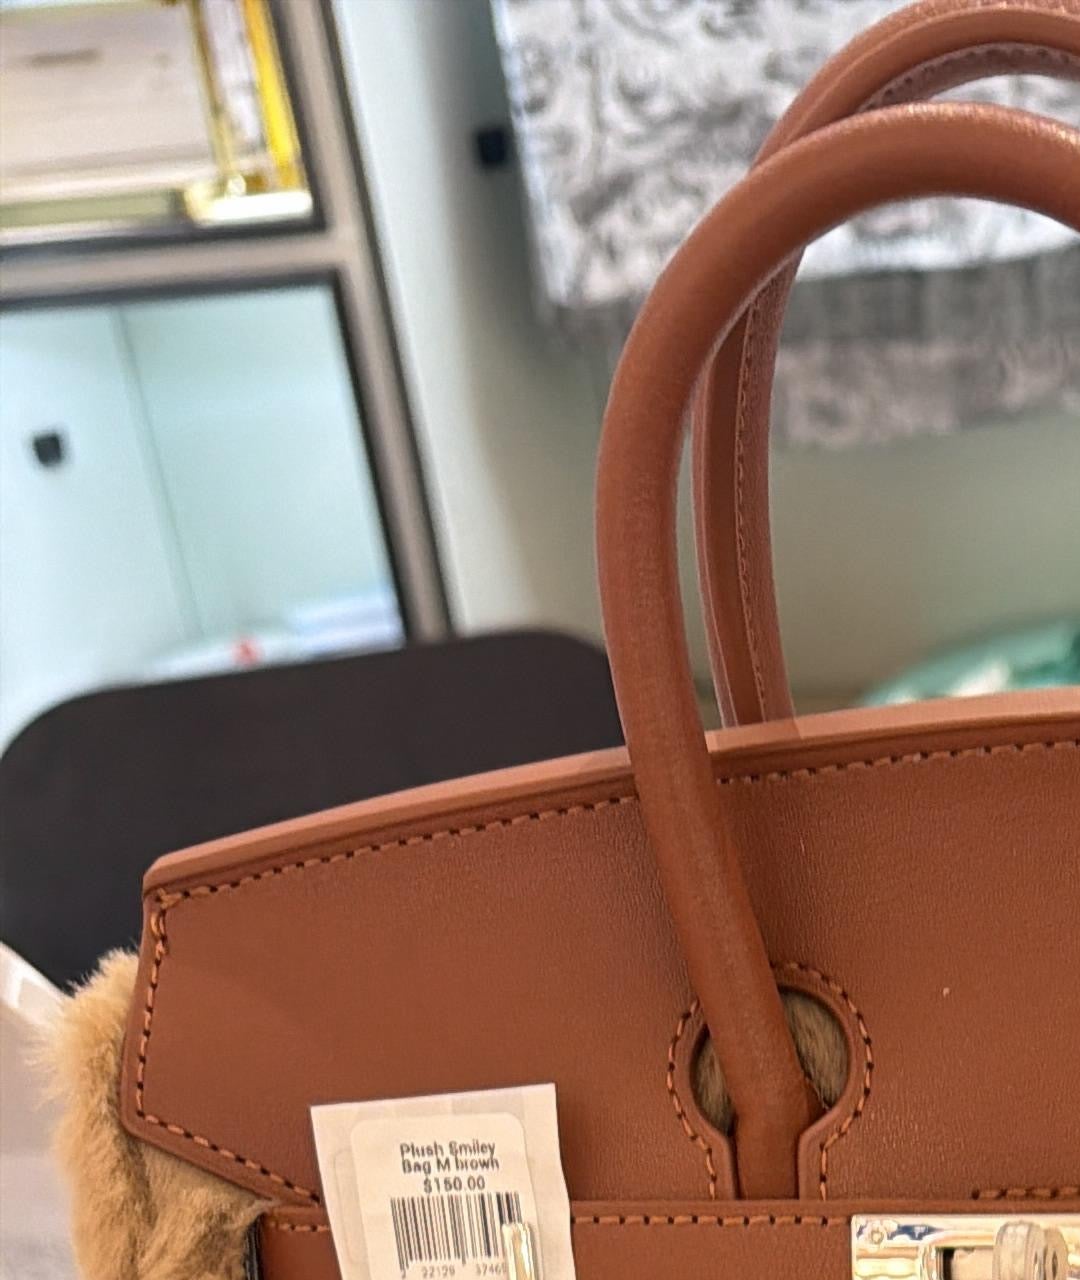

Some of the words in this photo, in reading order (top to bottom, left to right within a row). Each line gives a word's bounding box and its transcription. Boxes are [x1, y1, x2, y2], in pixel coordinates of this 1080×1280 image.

[400, 1141, 444, 1158] Plush
[449, 1138, 495, 1160] Smiley
[402, 1159, 431, 1175] Bag
[437, 1157, 451, 1172] M
[424, 1175, 486, 1194] $150.00
